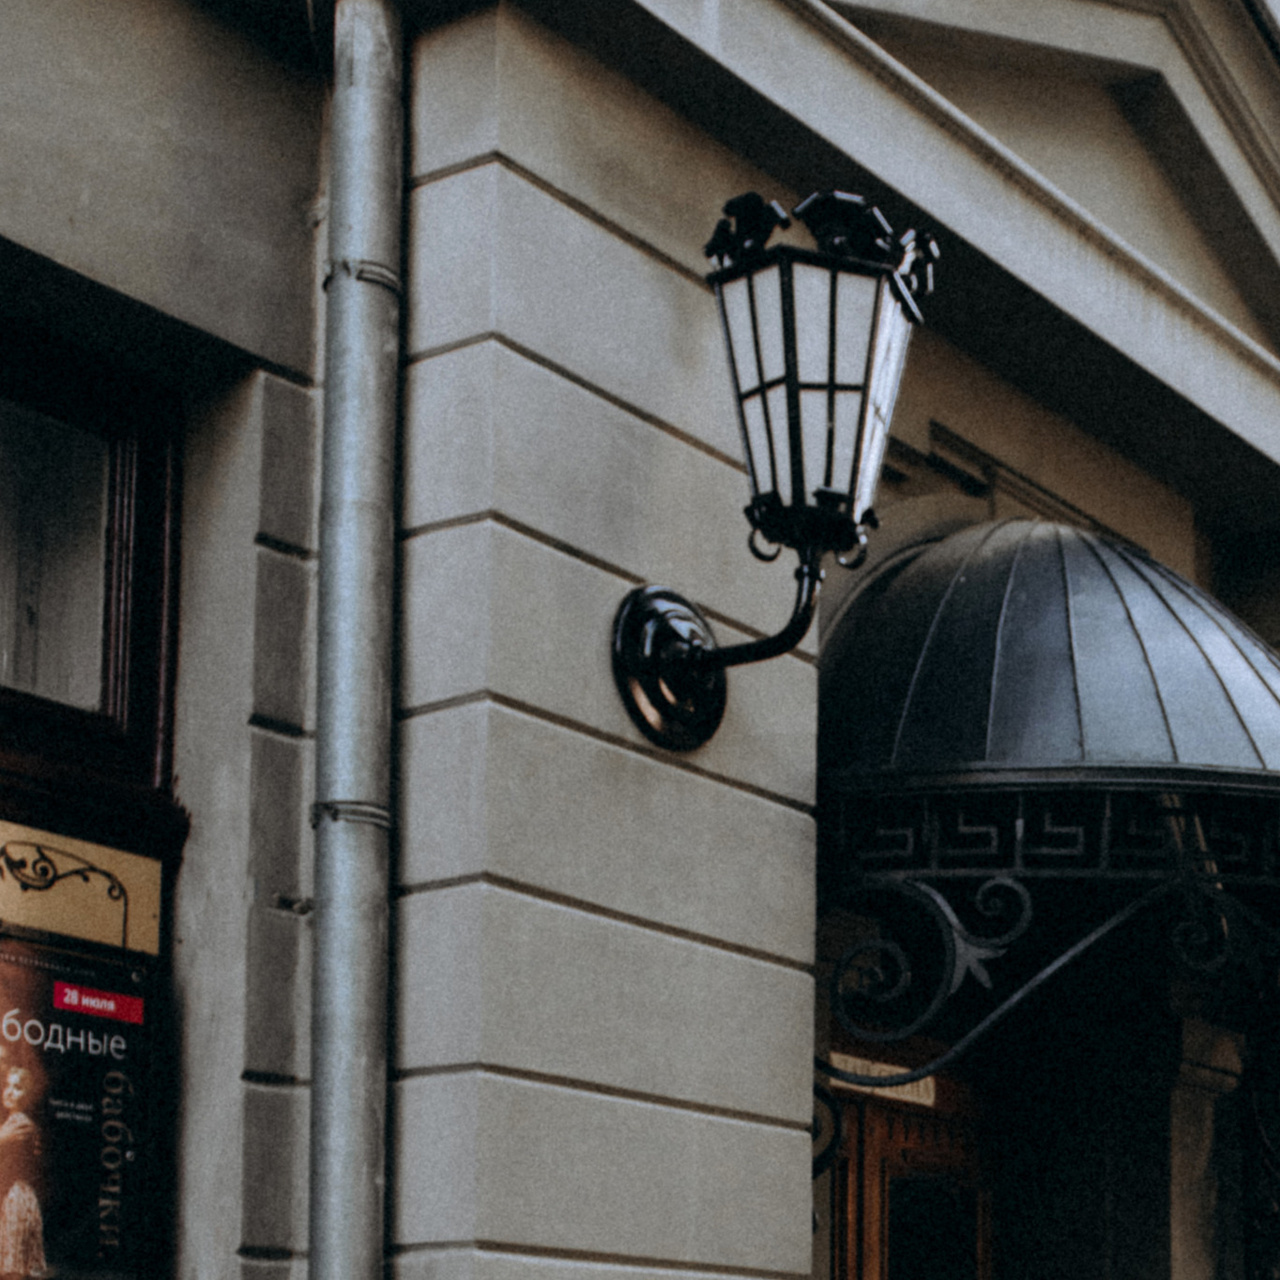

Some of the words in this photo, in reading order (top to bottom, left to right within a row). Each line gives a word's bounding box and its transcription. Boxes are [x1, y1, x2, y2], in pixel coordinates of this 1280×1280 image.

[63, 988, 79, 1005] 28
[81, 994, 116, 1012] июля
[1, 1008, 128, 1060] бодные
